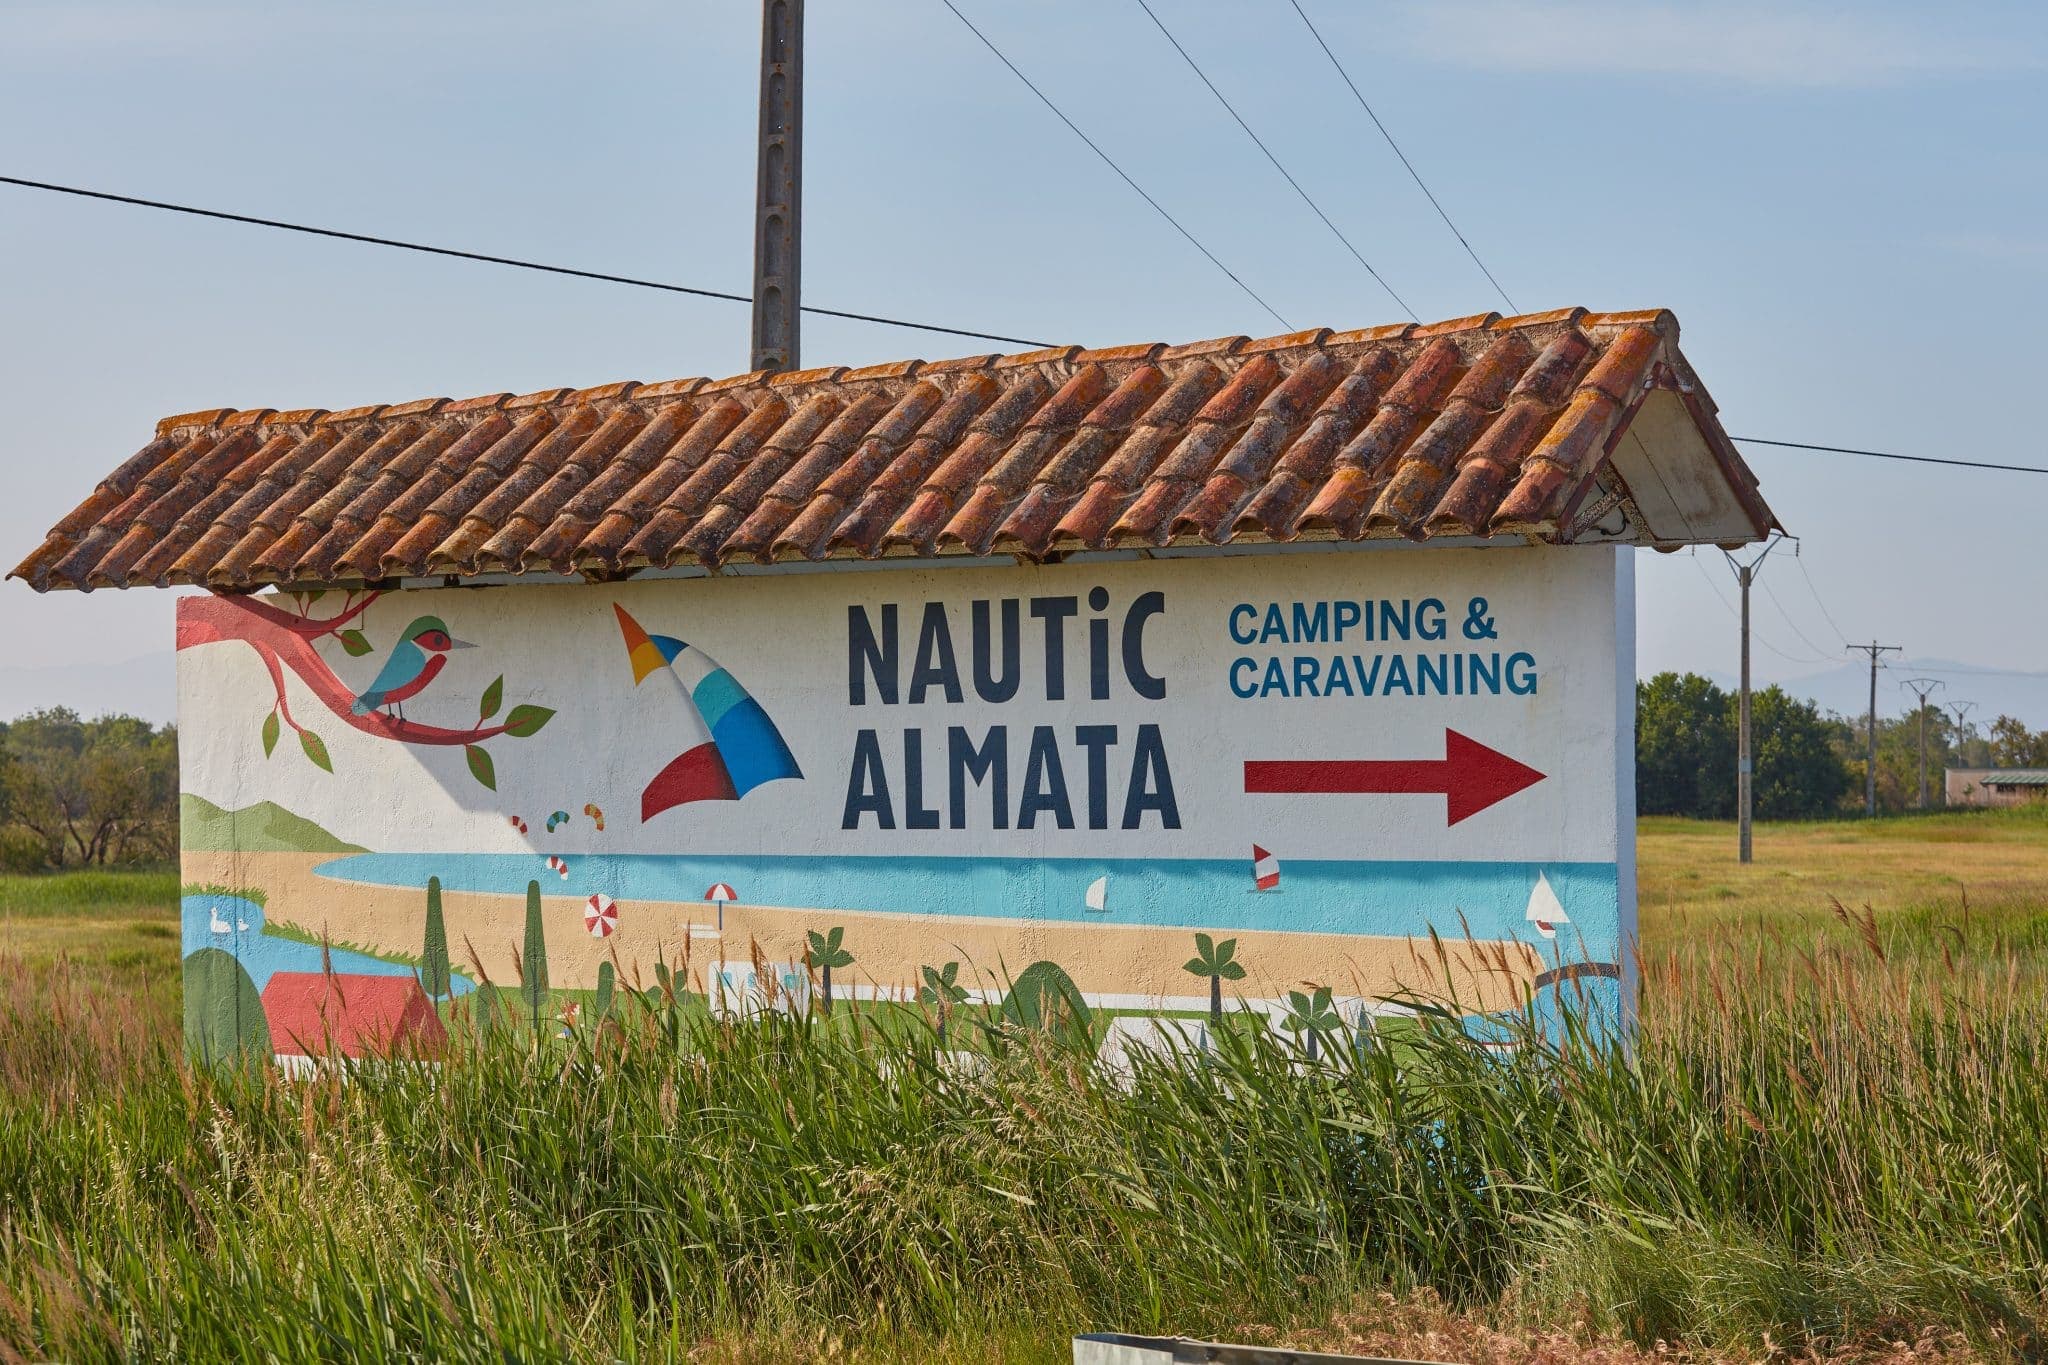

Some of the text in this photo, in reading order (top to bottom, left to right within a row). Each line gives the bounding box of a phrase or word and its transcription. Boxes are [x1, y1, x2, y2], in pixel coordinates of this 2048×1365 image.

[1228, 596, 1499, 646] CAMPING &
[1229, 651, 1538, 700] CARAVANING
[841, 723, 1182, 830] ALMATA
